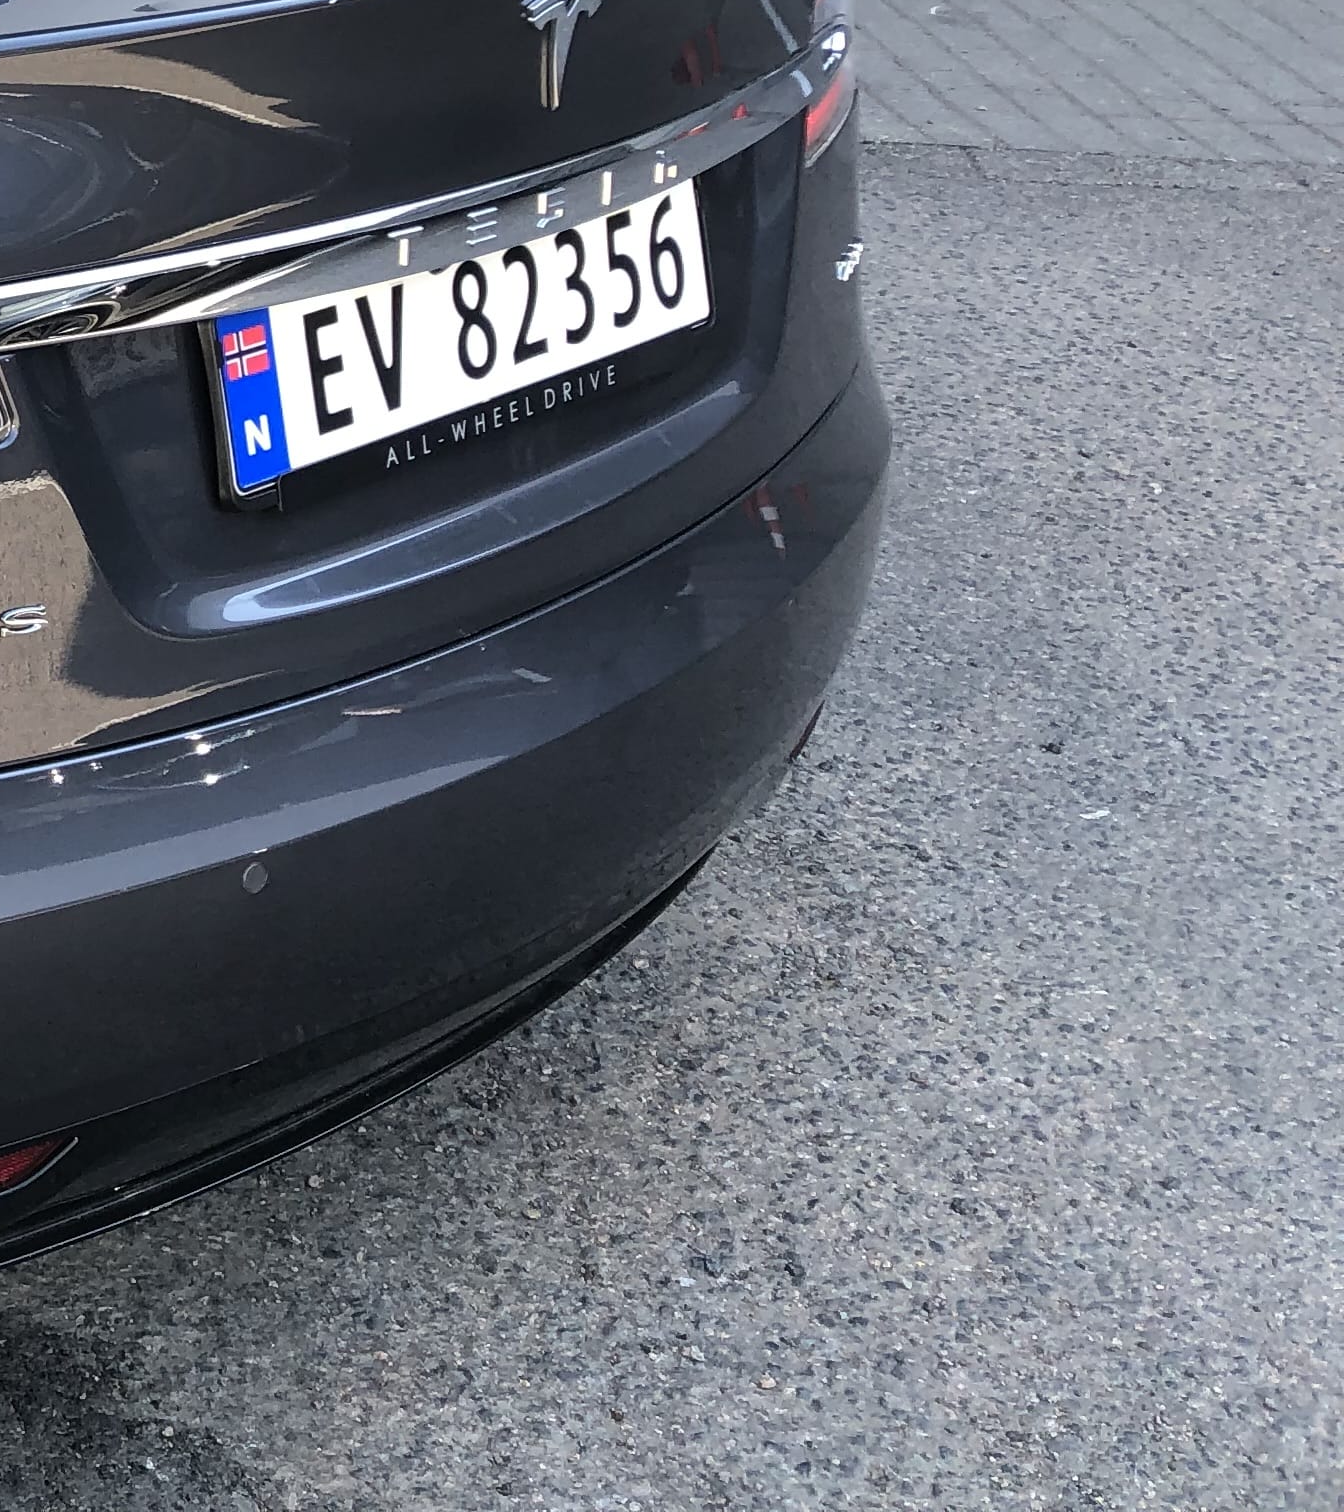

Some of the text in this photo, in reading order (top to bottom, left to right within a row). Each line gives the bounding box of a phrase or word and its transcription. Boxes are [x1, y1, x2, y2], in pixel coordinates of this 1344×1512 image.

[302, 195, 686, 436] EV 82356
[243, 414, 272, 456] N
[386, 364, 618, 469] ALL-WHEEL DRIVE
